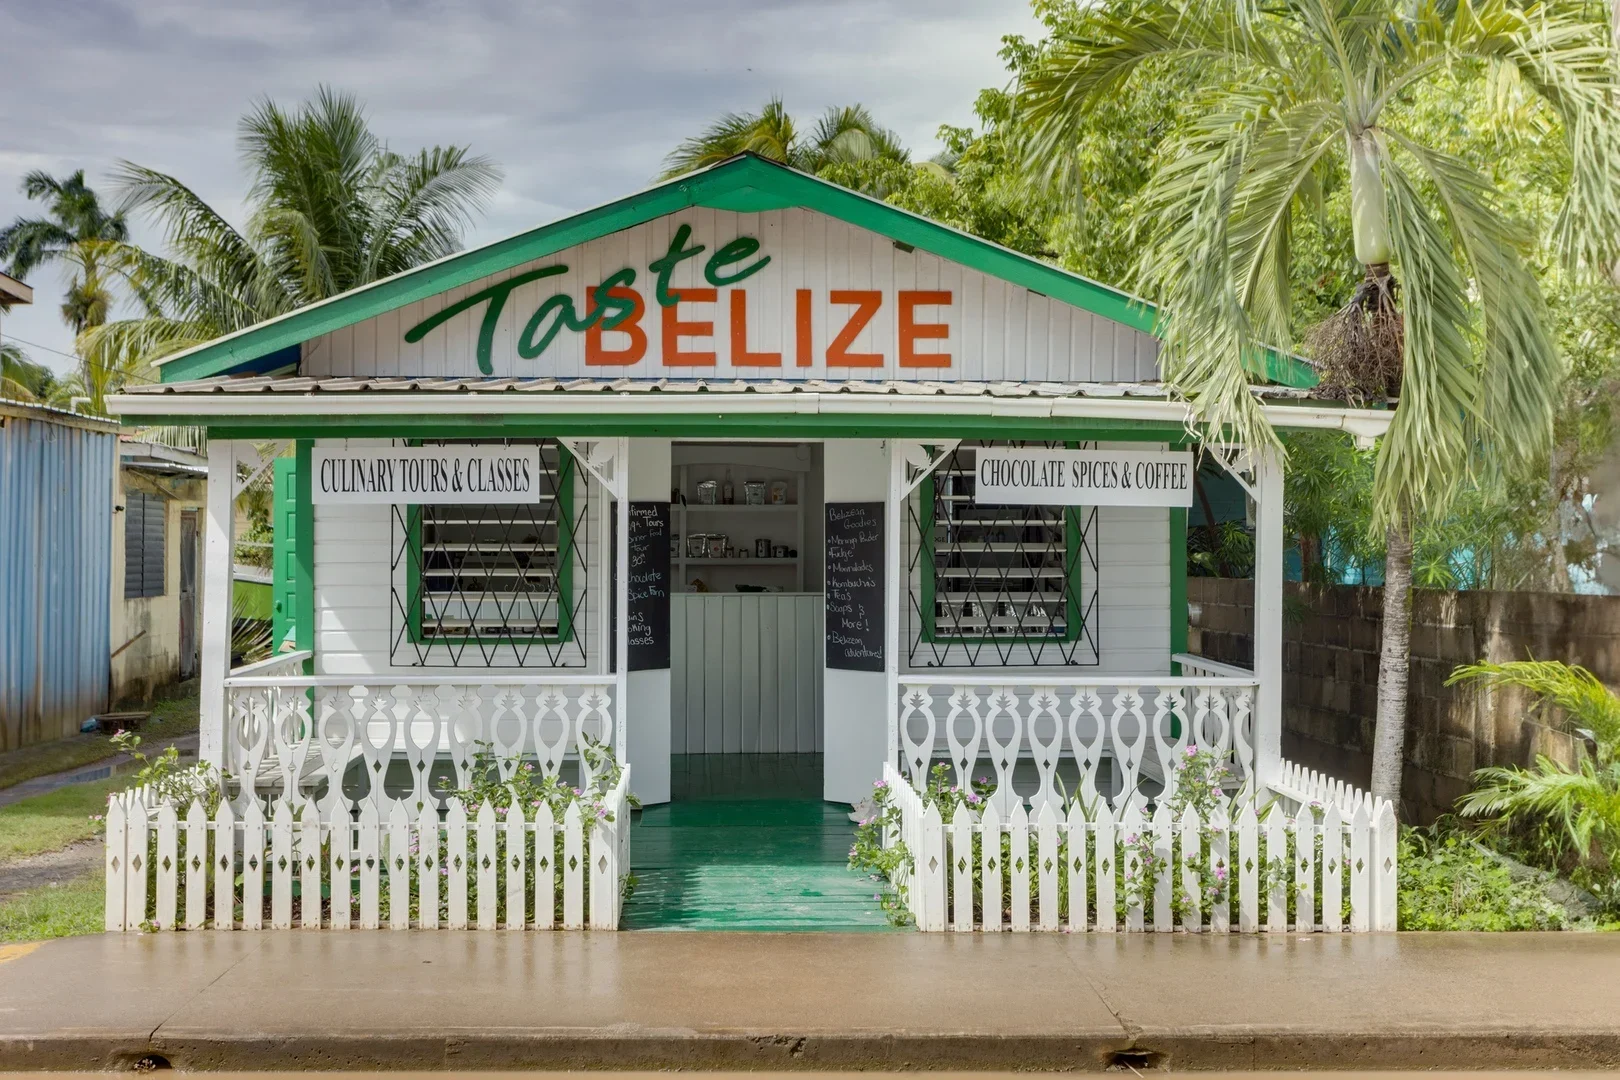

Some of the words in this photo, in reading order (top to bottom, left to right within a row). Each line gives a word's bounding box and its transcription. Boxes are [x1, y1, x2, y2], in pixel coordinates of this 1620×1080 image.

[404, 223, 772, 376] Taste
[584, 286, 953, 369] BELIZE
[320, 458, 396, 493] CULINARY
[399, 458, 448, 493] TOURS
[452, 458, 463, 493] &
[467, 457, 530, 493] CLASSES
[980, 458, 1065, 488] CHOCOLATE
[1072, 460, 1118, 489] SPICES
[1121, 462, 1132, 489] &
[1135, 462, 1188, 490] COFFEE
[642, 515, 664, 527] Tours
[844, 516, 877, 529] Goodies
[830, 547, 854, 562] Fudge
[628, 568, 662, 583] hocolate
[830, 602, 852, 615] Soaps
[628, 636, 654, 646] lasses
